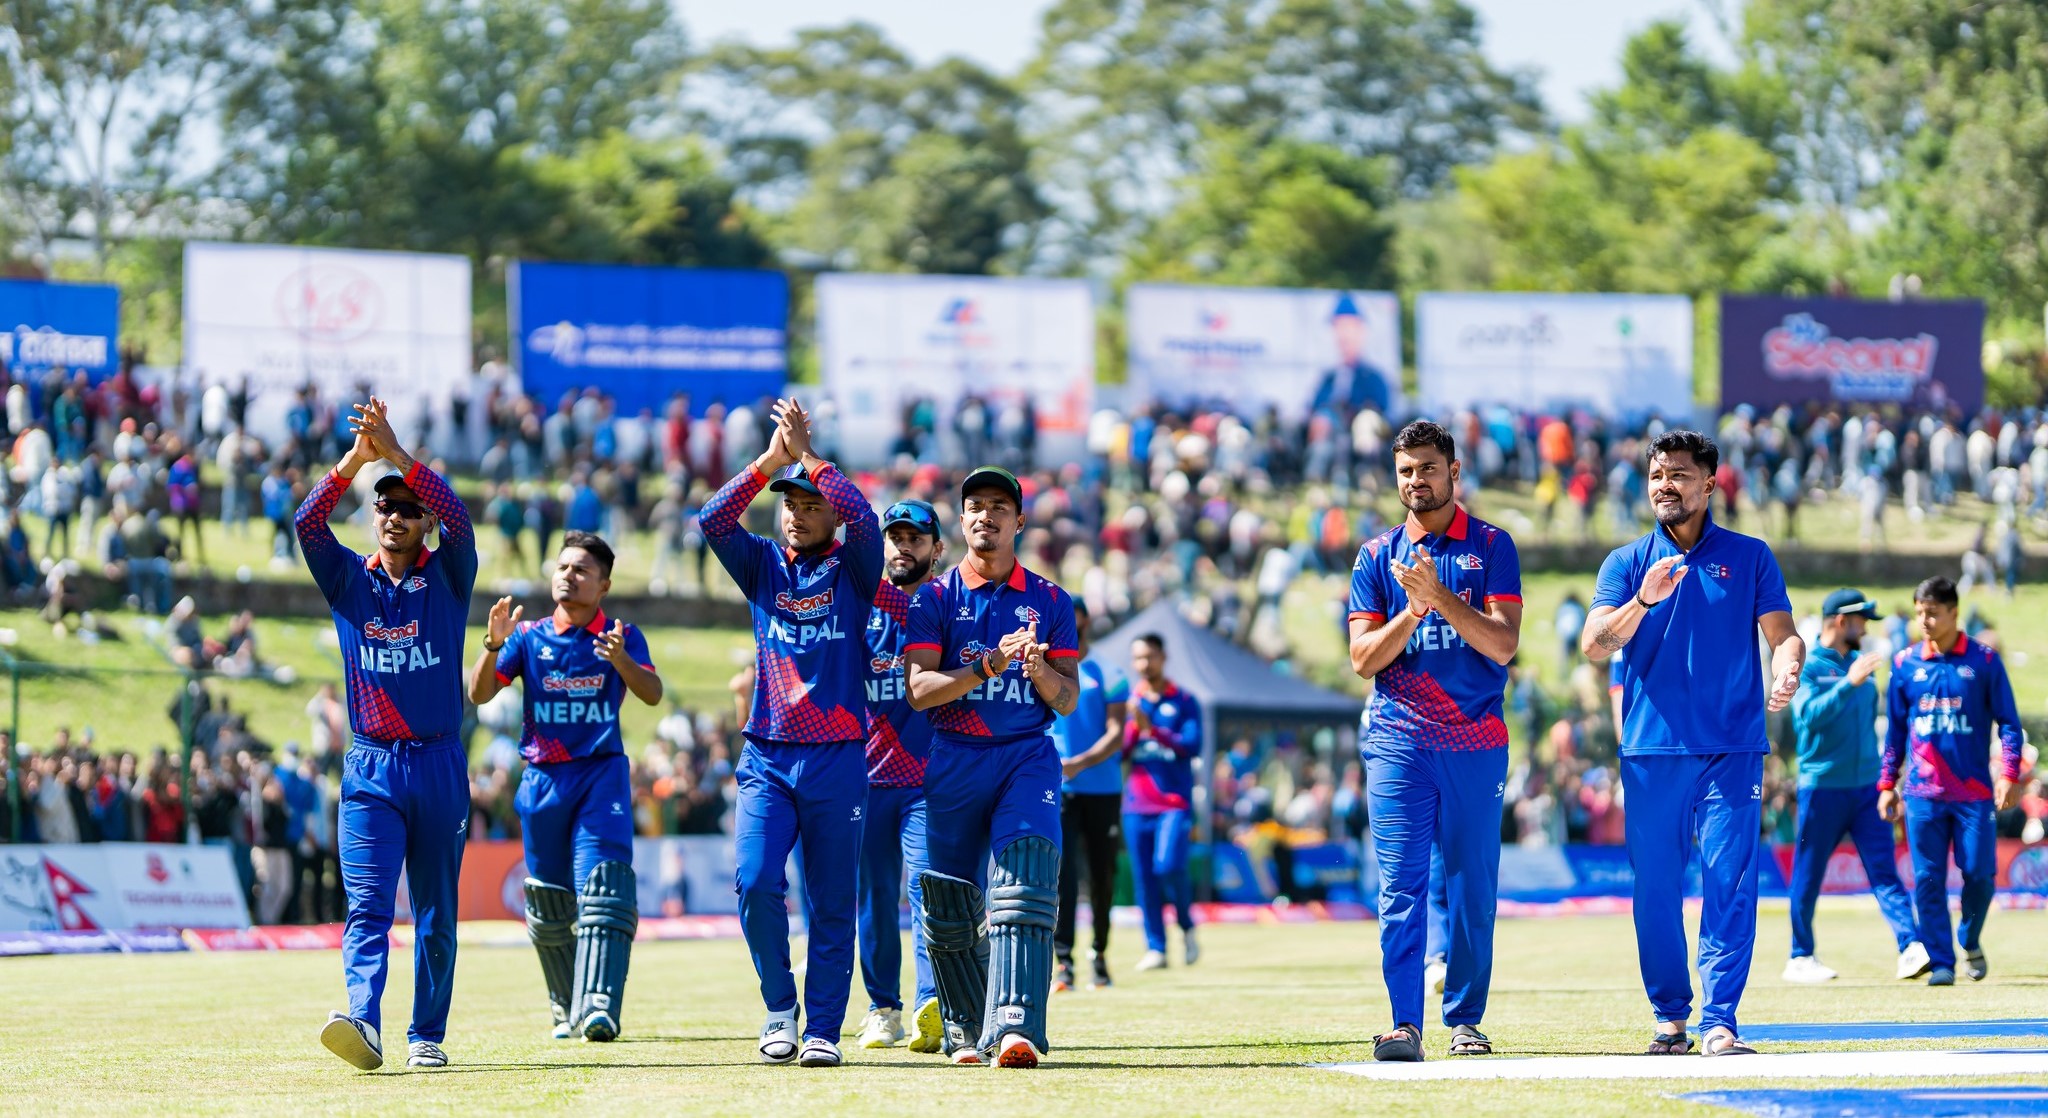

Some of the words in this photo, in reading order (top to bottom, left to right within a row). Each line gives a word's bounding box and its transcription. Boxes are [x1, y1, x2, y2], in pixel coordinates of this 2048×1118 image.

[768, 615, 846, 646] NEPAL
[360, 641, 441, 674] NEPAL
[534, 700, 616, 724] NEPAL
[767, 1021, 786, 1033] NIKE
